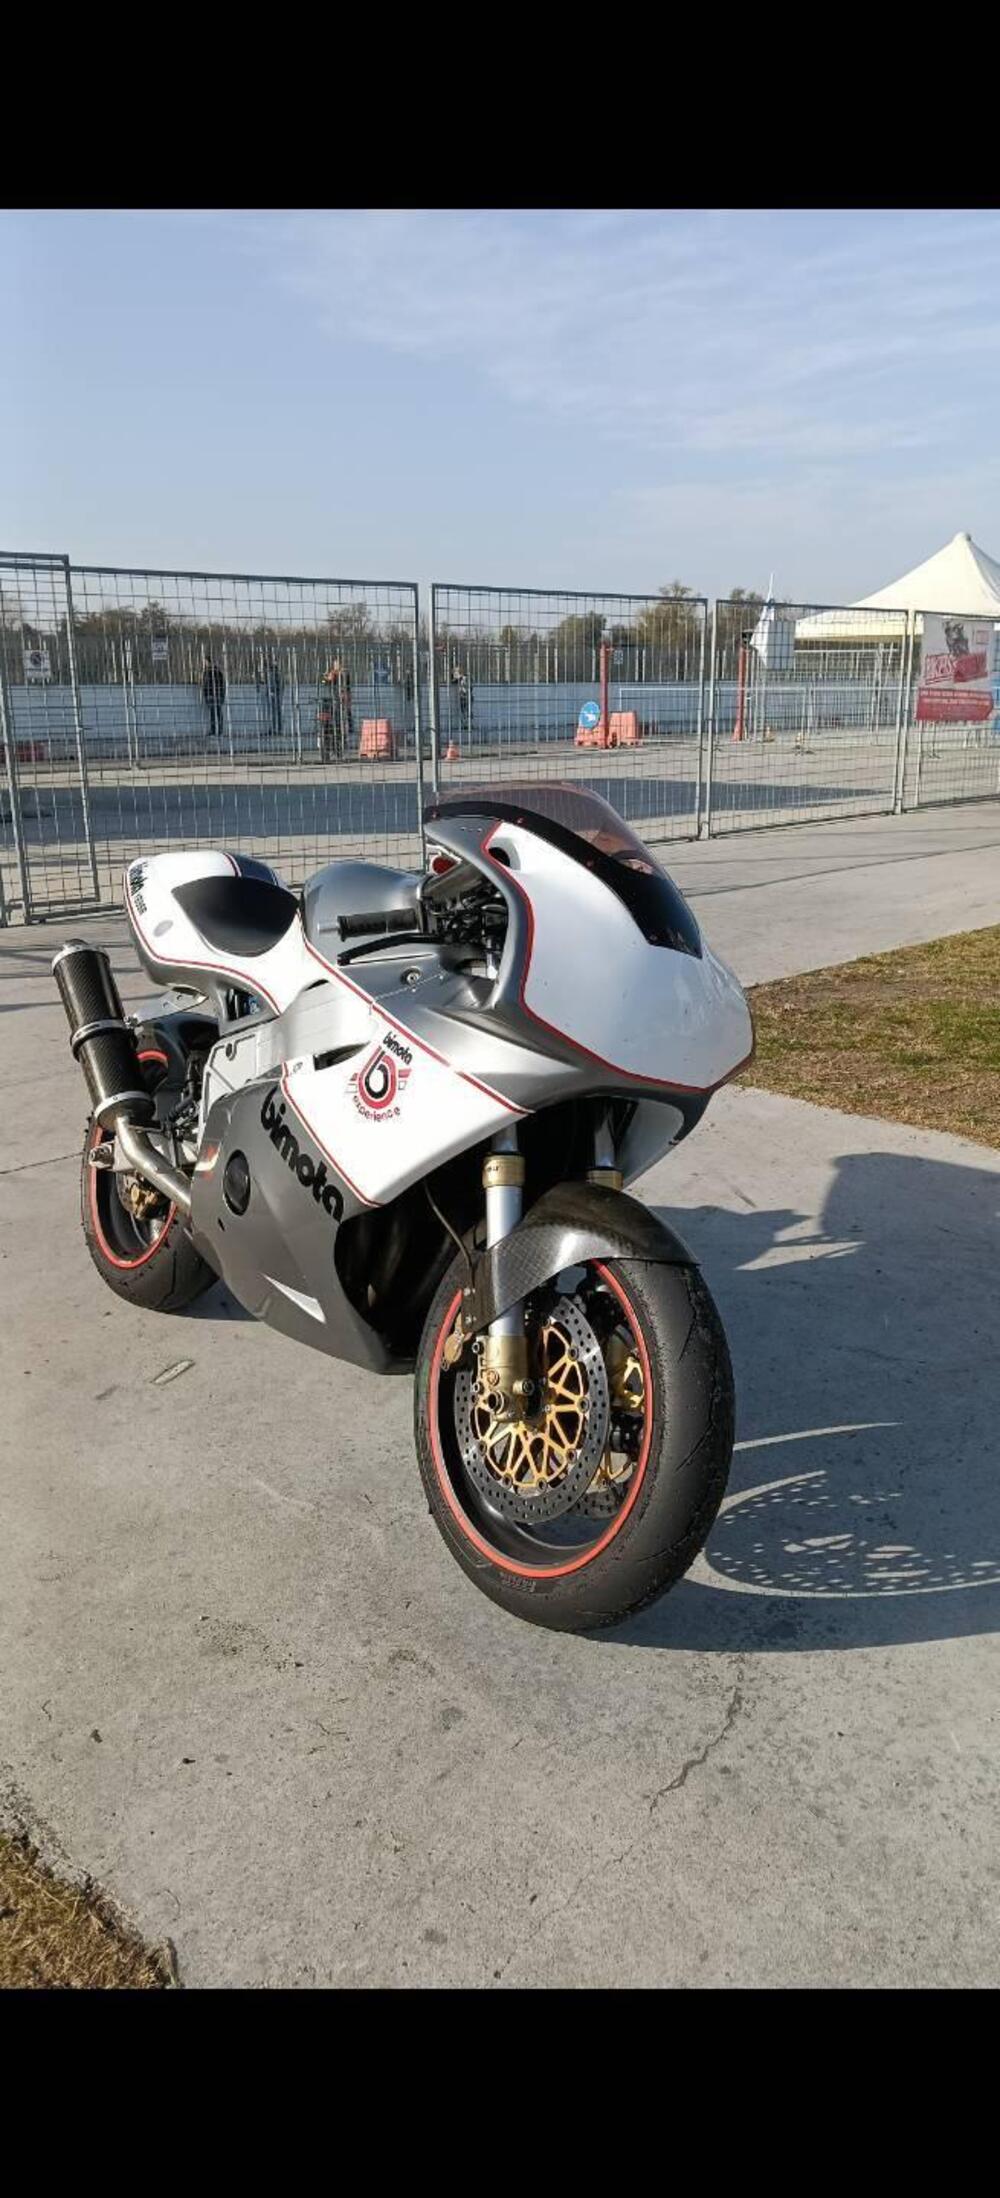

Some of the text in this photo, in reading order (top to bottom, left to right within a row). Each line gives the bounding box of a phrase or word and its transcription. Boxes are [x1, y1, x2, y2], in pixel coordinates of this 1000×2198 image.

[383, 1031, 413, 1065] bimota
[352, 1095, 401, 1122] experience
[260, 1084, 344, 1224] bimota
